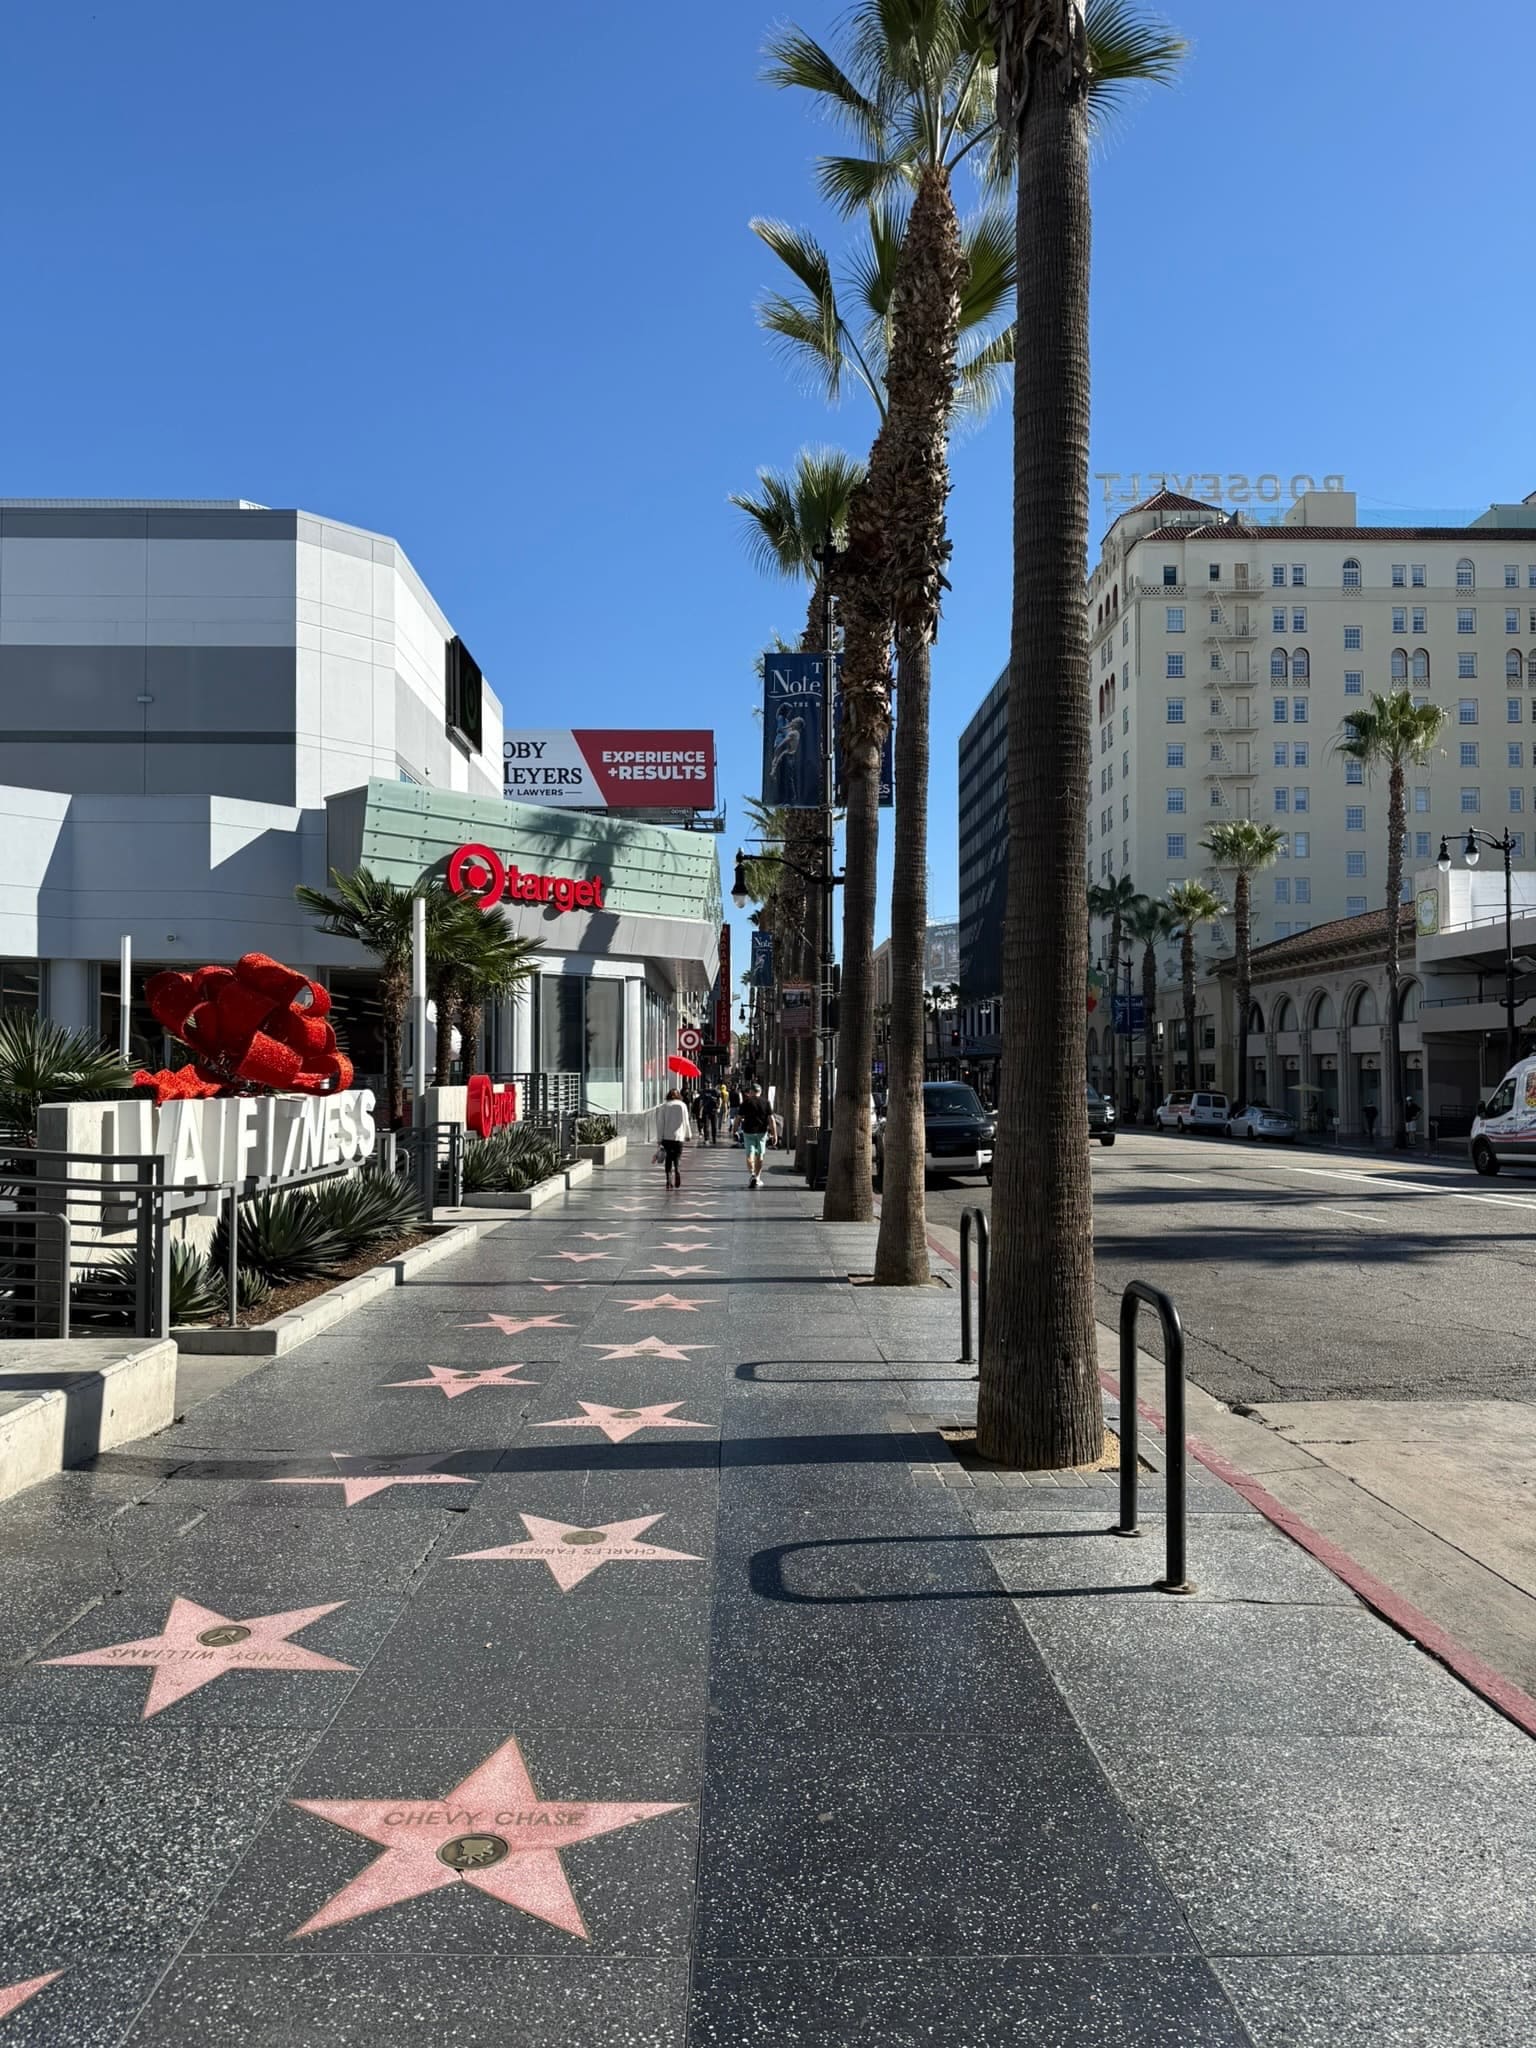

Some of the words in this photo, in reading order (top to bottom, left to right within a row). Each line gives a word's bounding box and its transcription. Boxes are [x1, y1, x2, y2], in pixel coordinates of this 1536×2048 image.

[602, 751, 705, 763] EXPERIENCE
[608, 765, 707, 780] +RESULTS
[517, 788, 563, 796] LAWYERS
[507, 864, 604, 912] target
[583, 1547, 656, 1556] CHARLES
[105, 1649, 215, 1661] WILLIAMS
[228, 1652, 299, 1662] CINDY
[384, 1811, 482, 1827] CHEVY
[494, 1811, 586, 1827] CHASE
